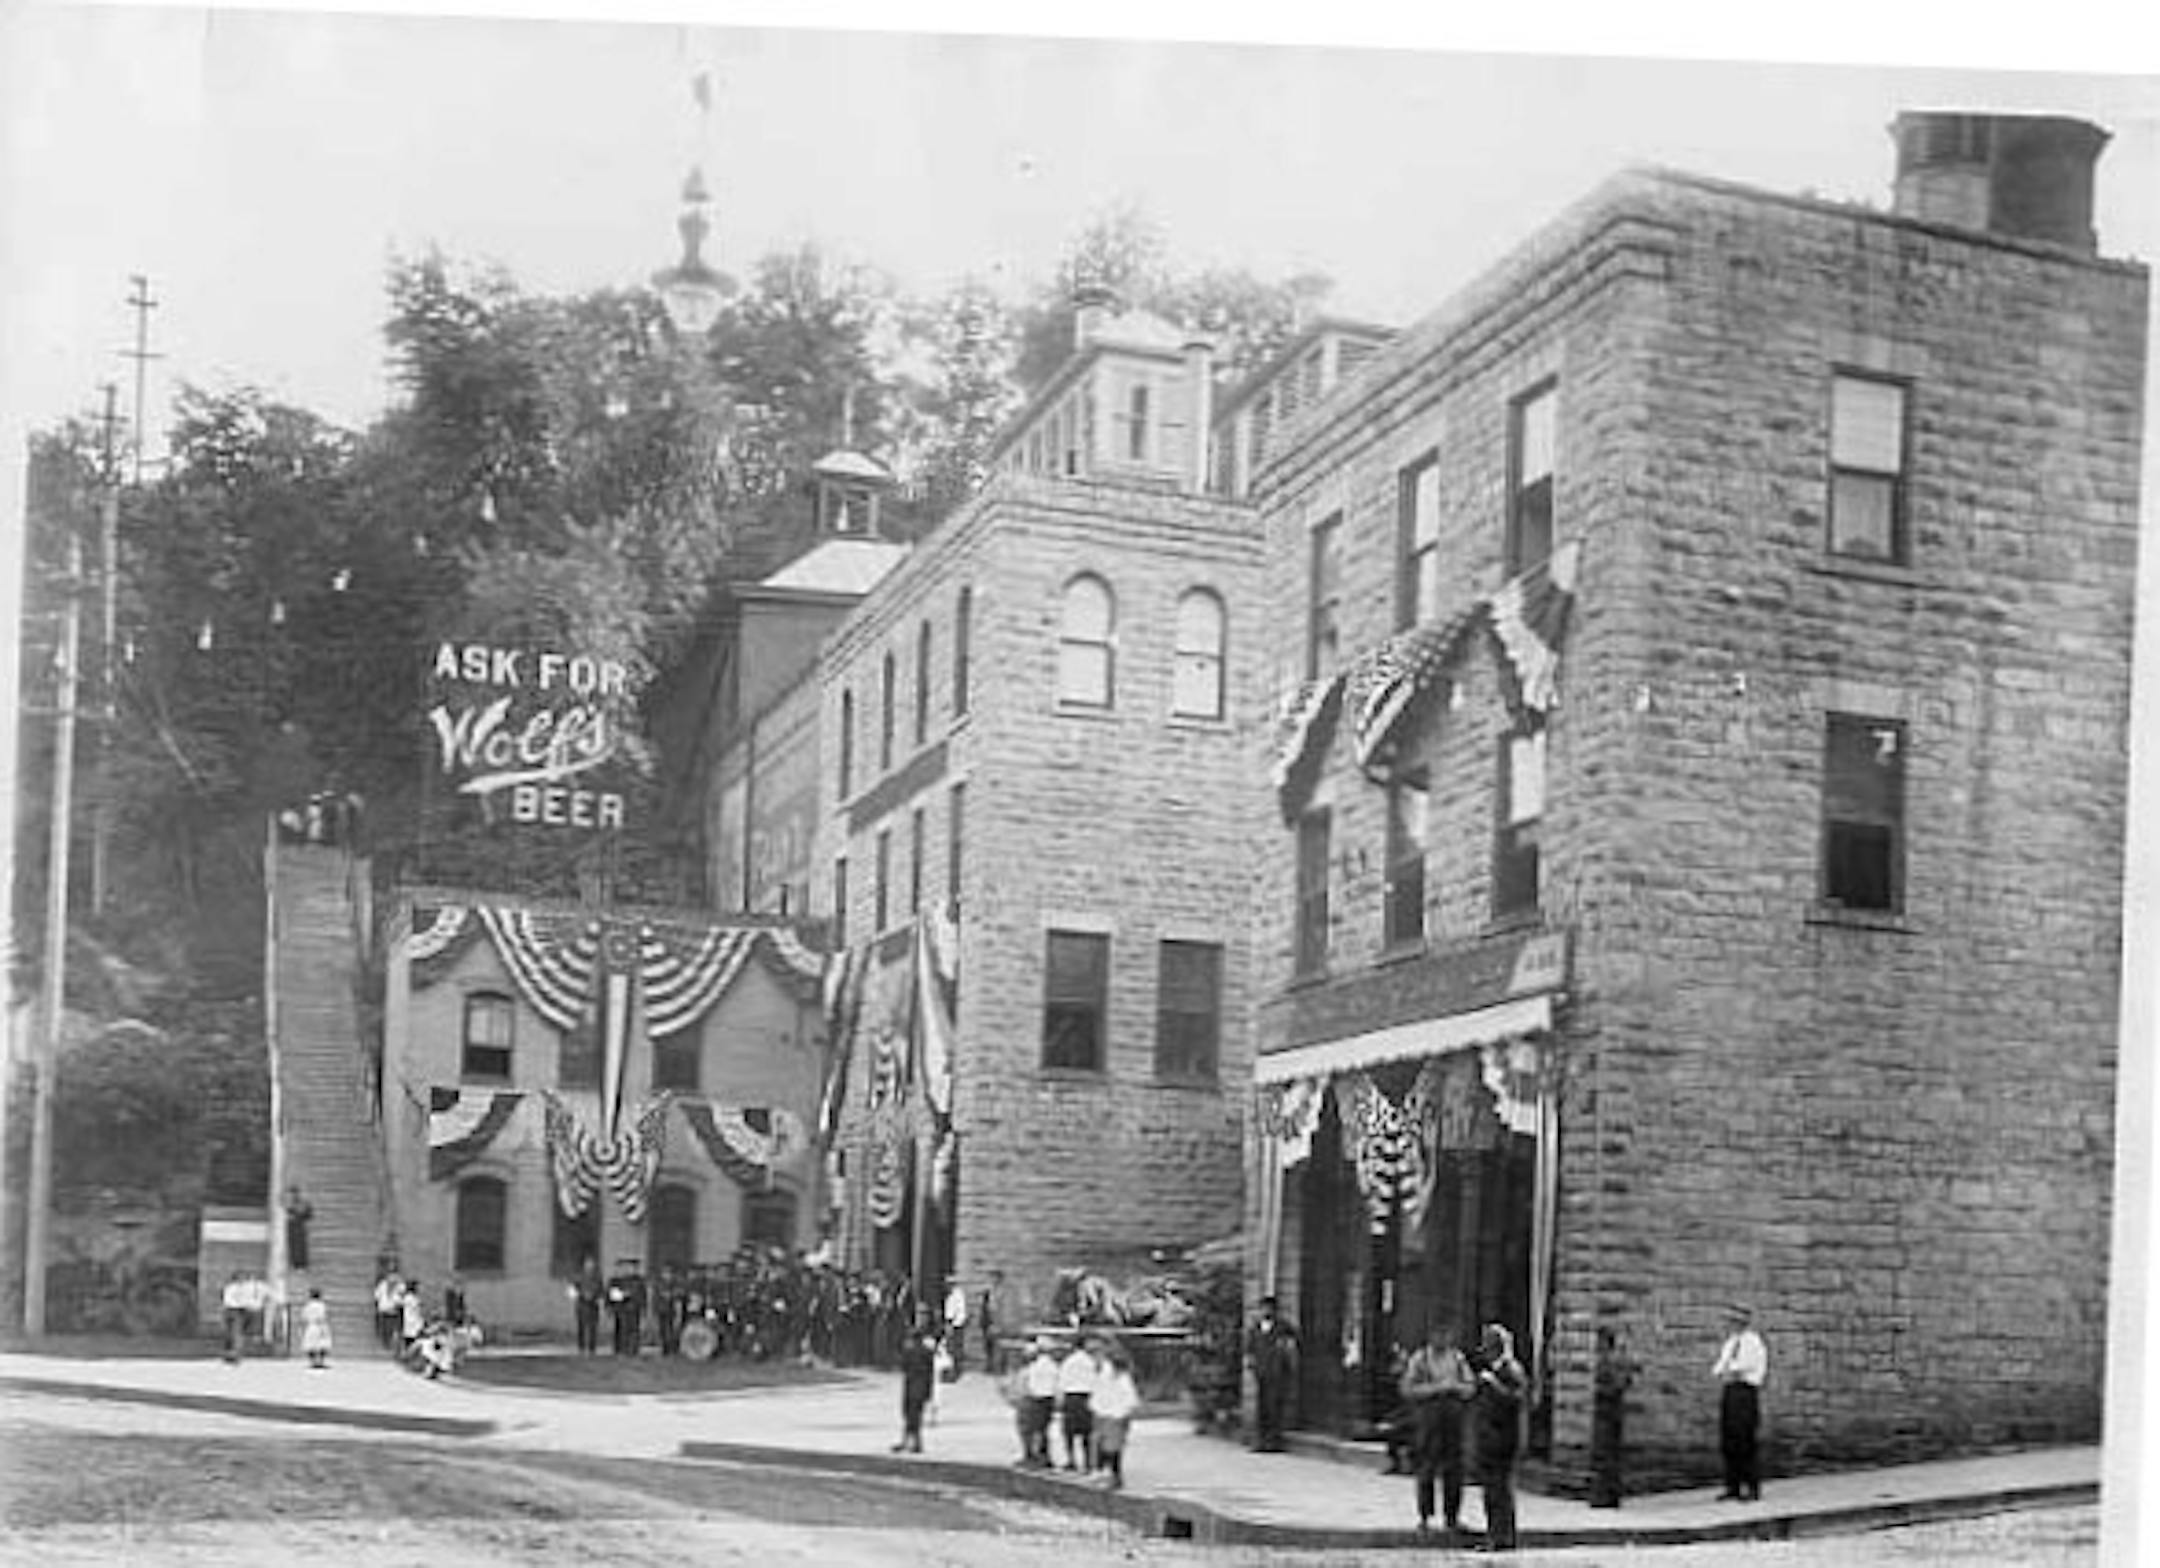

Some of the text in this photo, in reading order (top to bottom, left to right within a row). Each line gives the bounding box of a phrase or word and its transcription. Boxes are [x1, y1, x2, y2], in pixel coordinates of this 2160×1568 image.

[435, 643, 626, 694] ASK FOR
[513, 785, 623, 828] BEER
